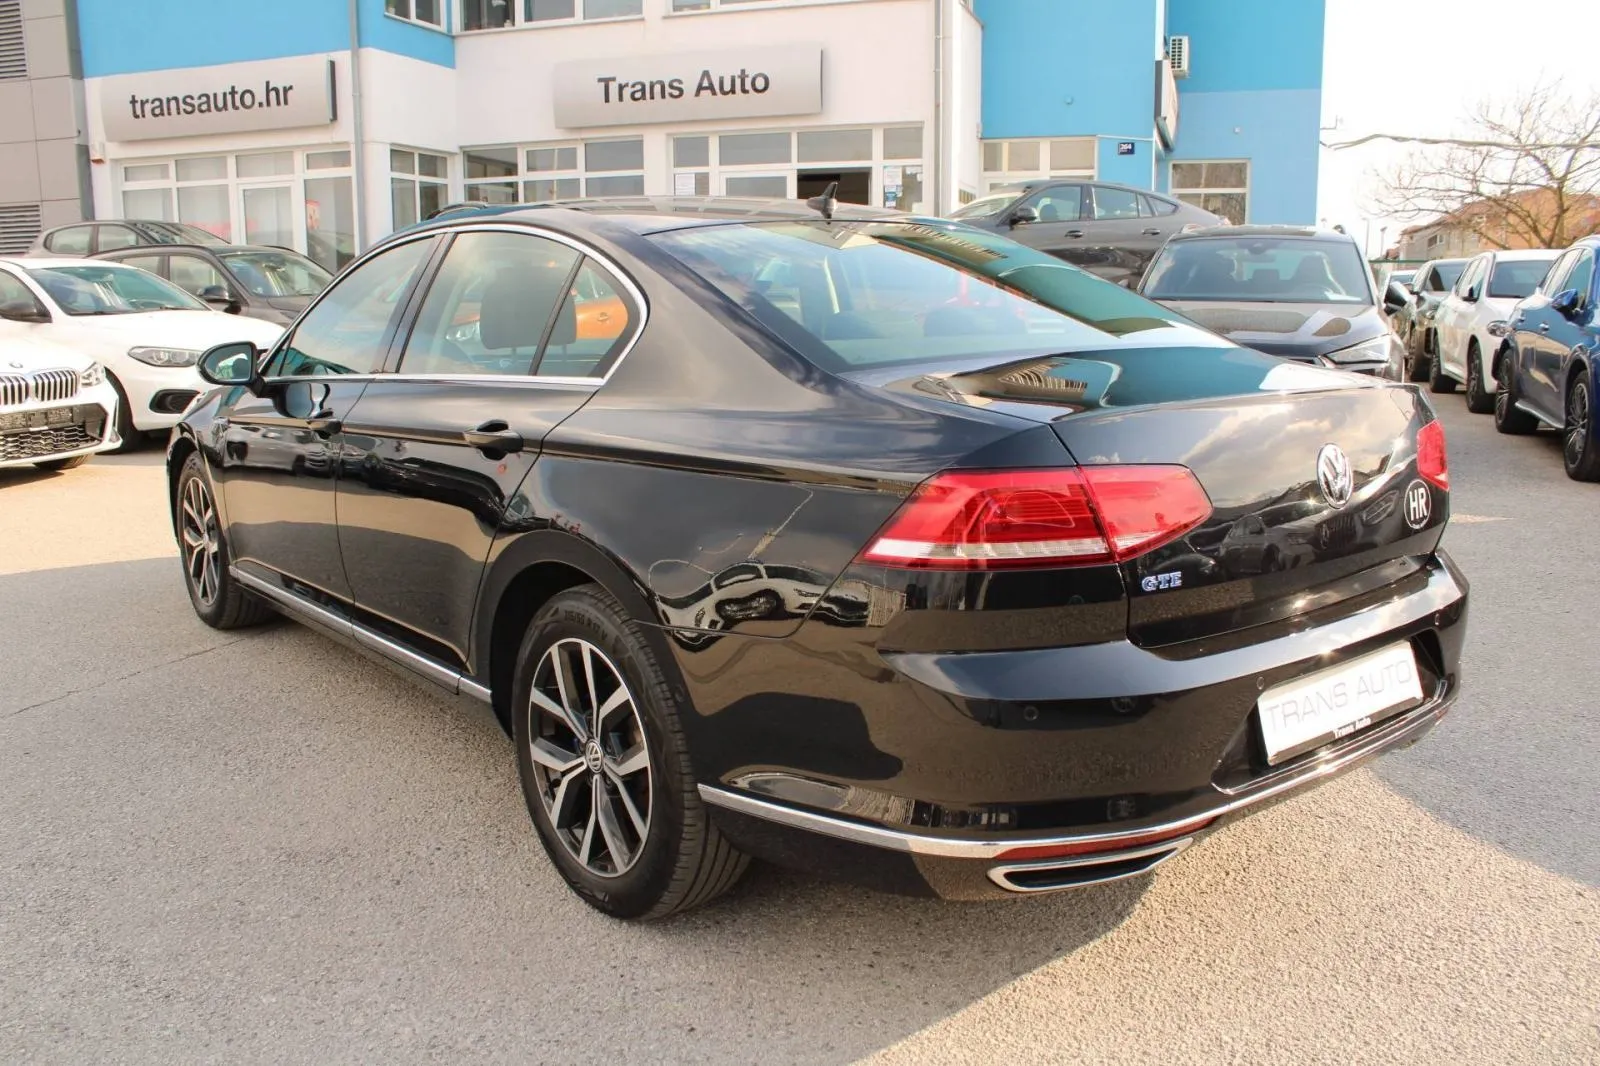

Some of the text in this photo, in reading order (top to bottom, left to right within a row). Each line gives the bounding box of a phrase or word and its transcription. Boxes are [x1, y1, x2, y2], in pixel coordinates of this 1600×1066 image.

[129, 80, 293, 120] transauto.hr
[597, 69, 770, 104] Trans Auto
[1409, 487, 1428, 521] HR
[1141, 571, 1182, 592] GTE
[1264, 658, 1413, 733] TRANS AUTO
[1333, 715, 1372, 740] Trans Auto
